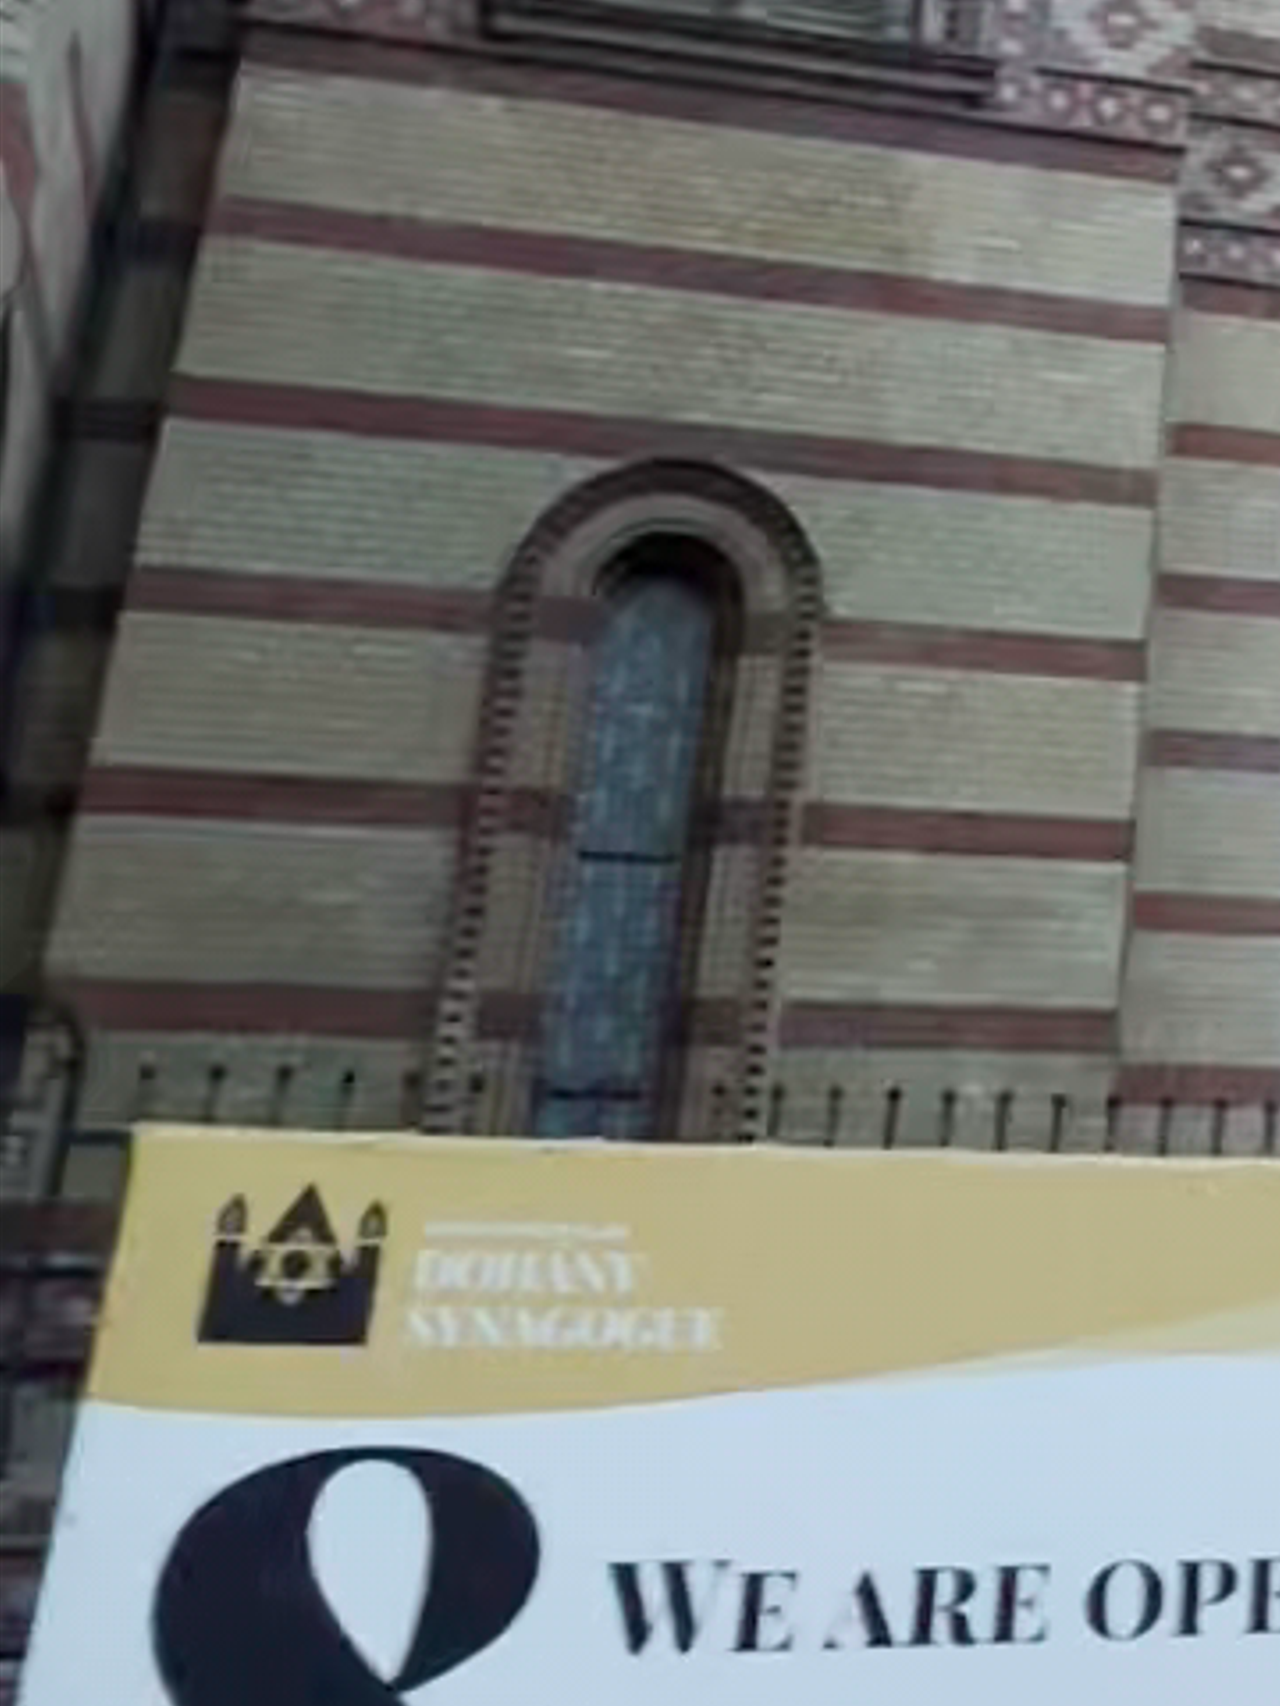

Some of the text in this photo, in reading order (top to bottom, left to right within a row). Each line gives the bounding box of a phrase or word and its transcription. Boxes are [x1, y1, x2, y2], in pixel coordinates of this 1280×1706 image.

[402, 1305, 725, 1351] SYNAGOGUE
[608, 1558, 798, 1656] WE
[822, 1564, 1051, 1650] ARE
